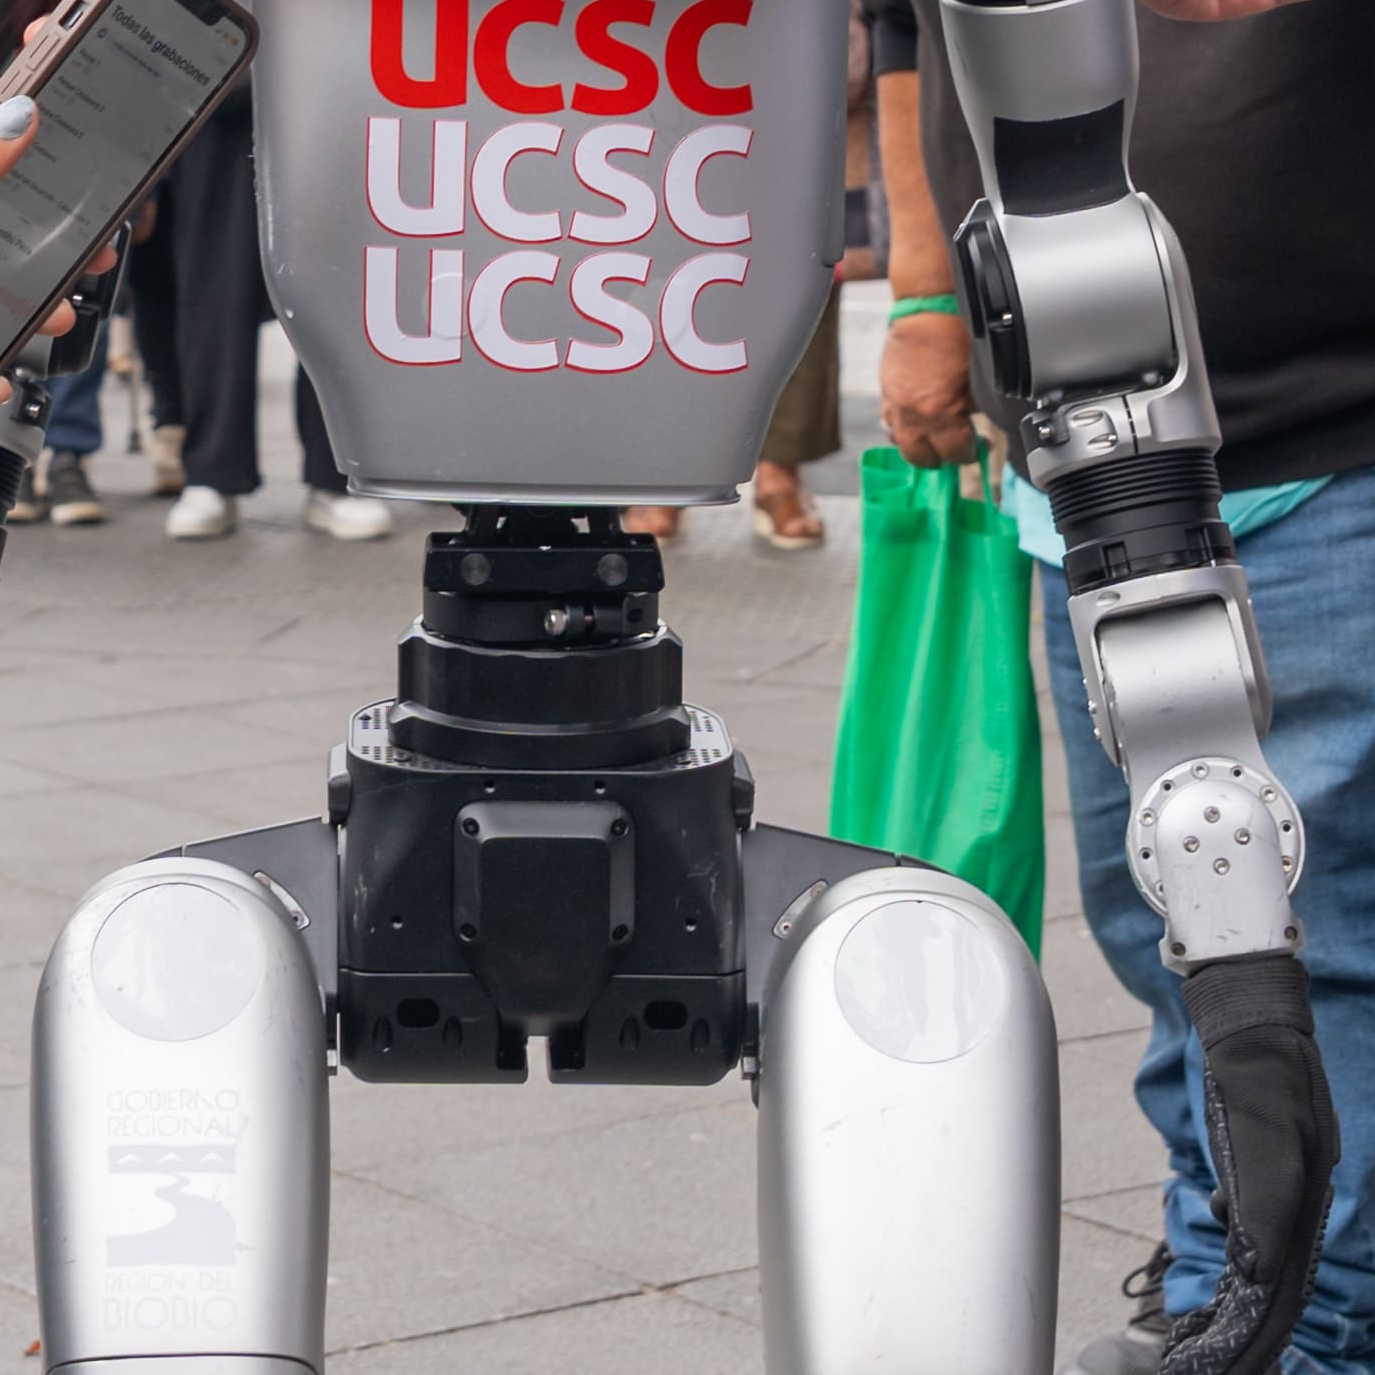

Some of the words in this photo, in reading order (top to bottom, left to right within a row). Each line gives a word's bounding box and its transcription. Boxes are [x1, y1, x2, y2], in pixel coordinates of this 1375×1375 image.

[111, 4, 139, 34] Todas
[137, 26, 156, 45] las
[150, 39, 211, 86] grabaciones
[364, 115, 756, 247] UCSC
[363, 245, 752, 375] UCSC
[105, 1088, 240, 1113] GOBIERNO
[105, 1113, 242, 1138] REGIONAL
[104, 1272, 186, 1293] REGION
[198, 1272, 236, 1293] DEL
[104, 1296, 238, 1332] BIOBIO
